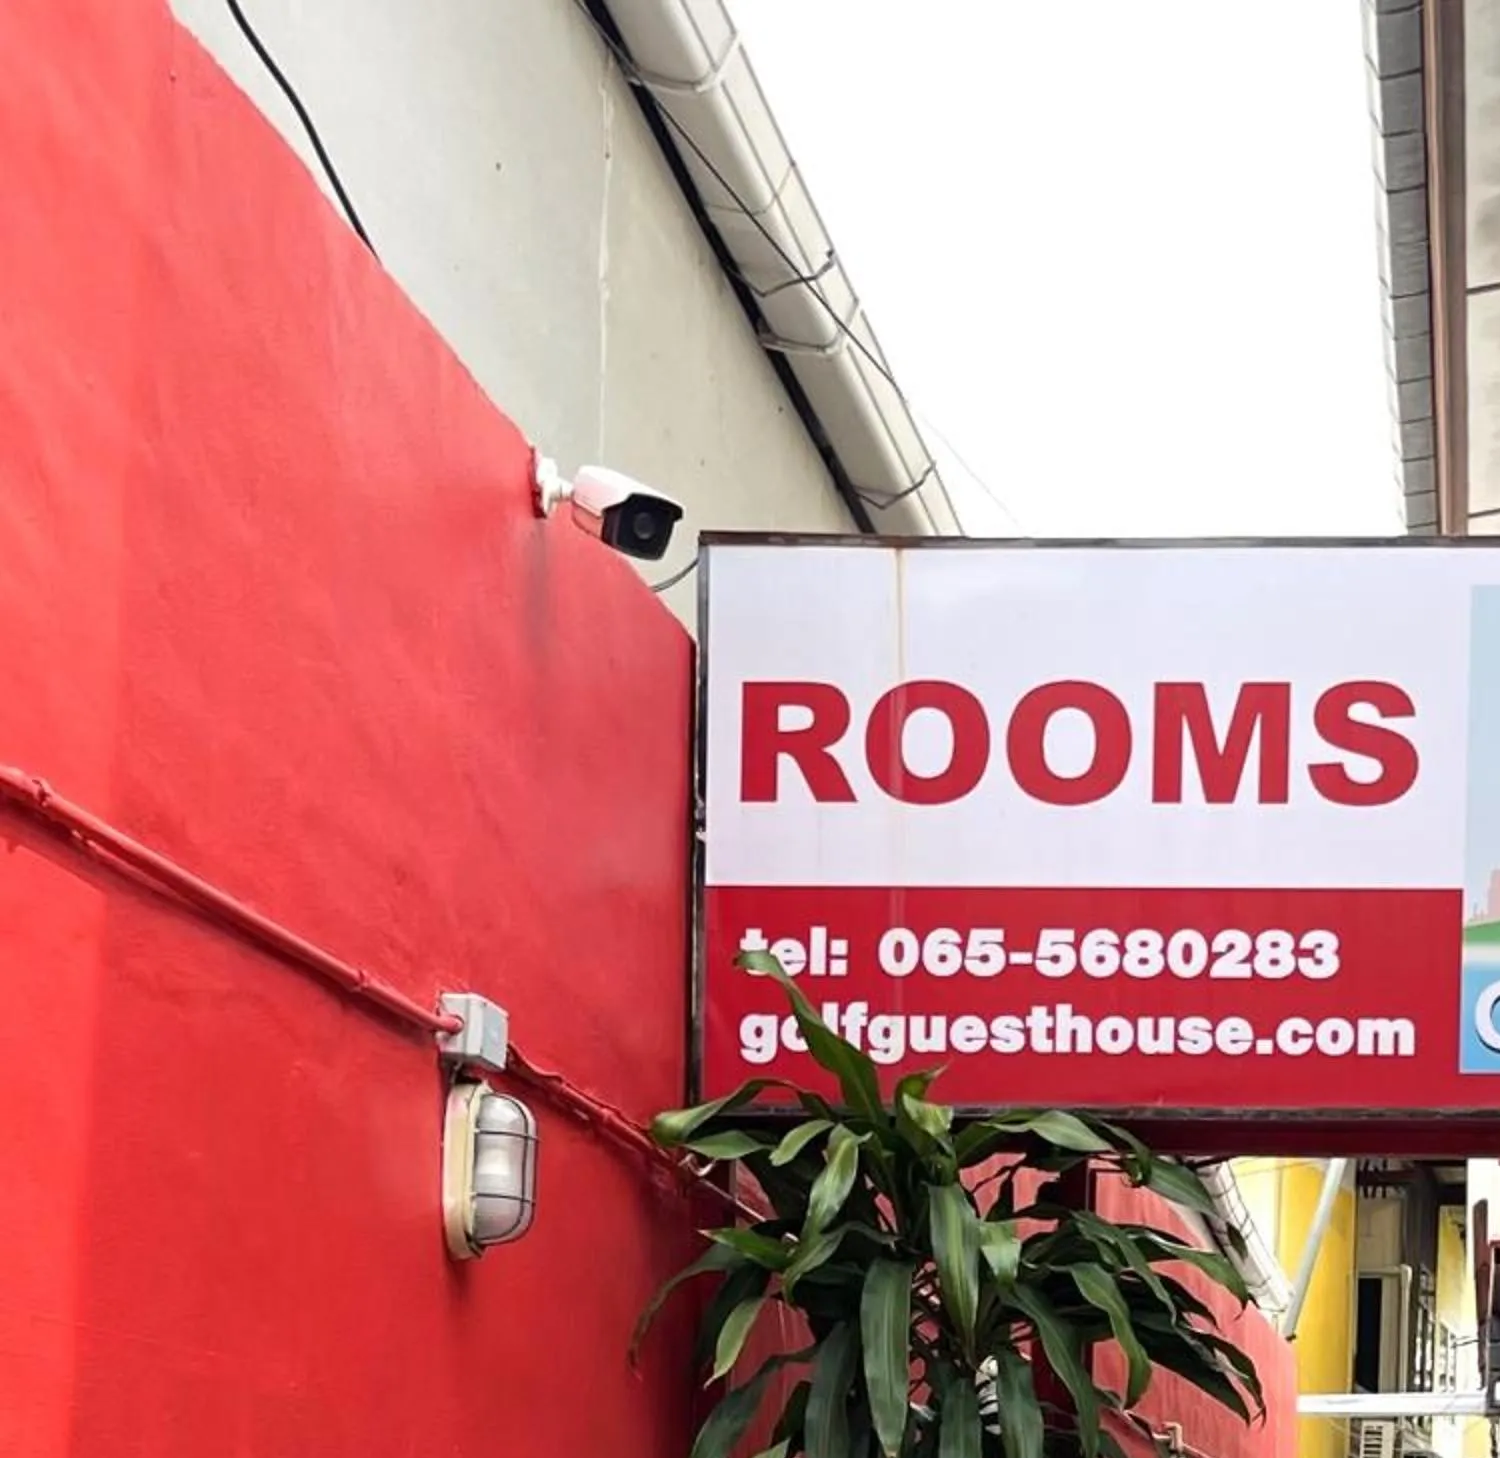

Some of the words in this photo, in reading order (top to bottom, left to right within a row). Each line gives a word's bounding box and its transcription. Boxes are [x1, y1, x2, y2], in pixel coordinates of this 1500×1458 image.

[740, 679, 1419, 807] ROOMS
[739, 926, 849, 977] tel:
[878, 927, 1341, 979] 065-5680283
[739, 1001, 1416, 1064] golfguesthouse.com
